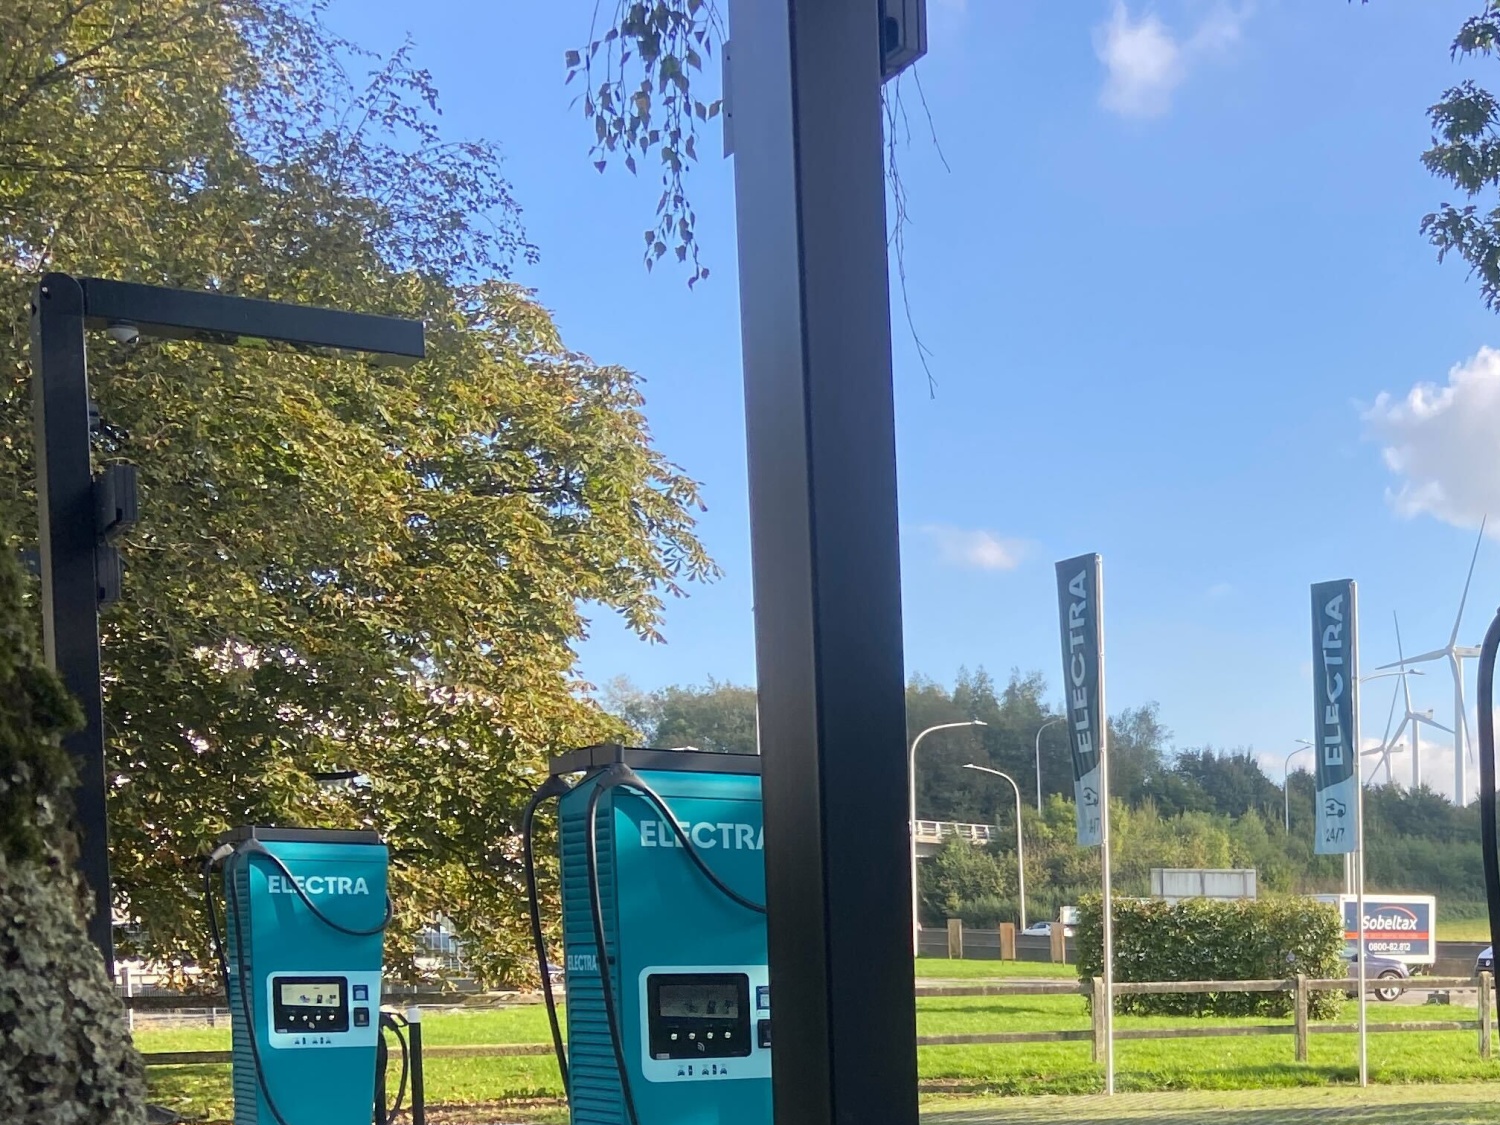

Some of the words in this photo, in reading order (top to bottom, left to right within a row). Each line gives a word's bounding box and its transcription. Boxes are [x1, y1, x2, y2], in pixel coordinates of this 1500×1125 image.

[1068, 569, 1093, 755] ELECTRA
[1322, 593, 1343, 767] ELECTRA
[1326, 827, 1345, 844] 24/7
[268, 875, 370, 895] ELECTRA
[1362, 914, 1418, 930] Sobeltax
[567, 954, 599, 971] ELECTRA
